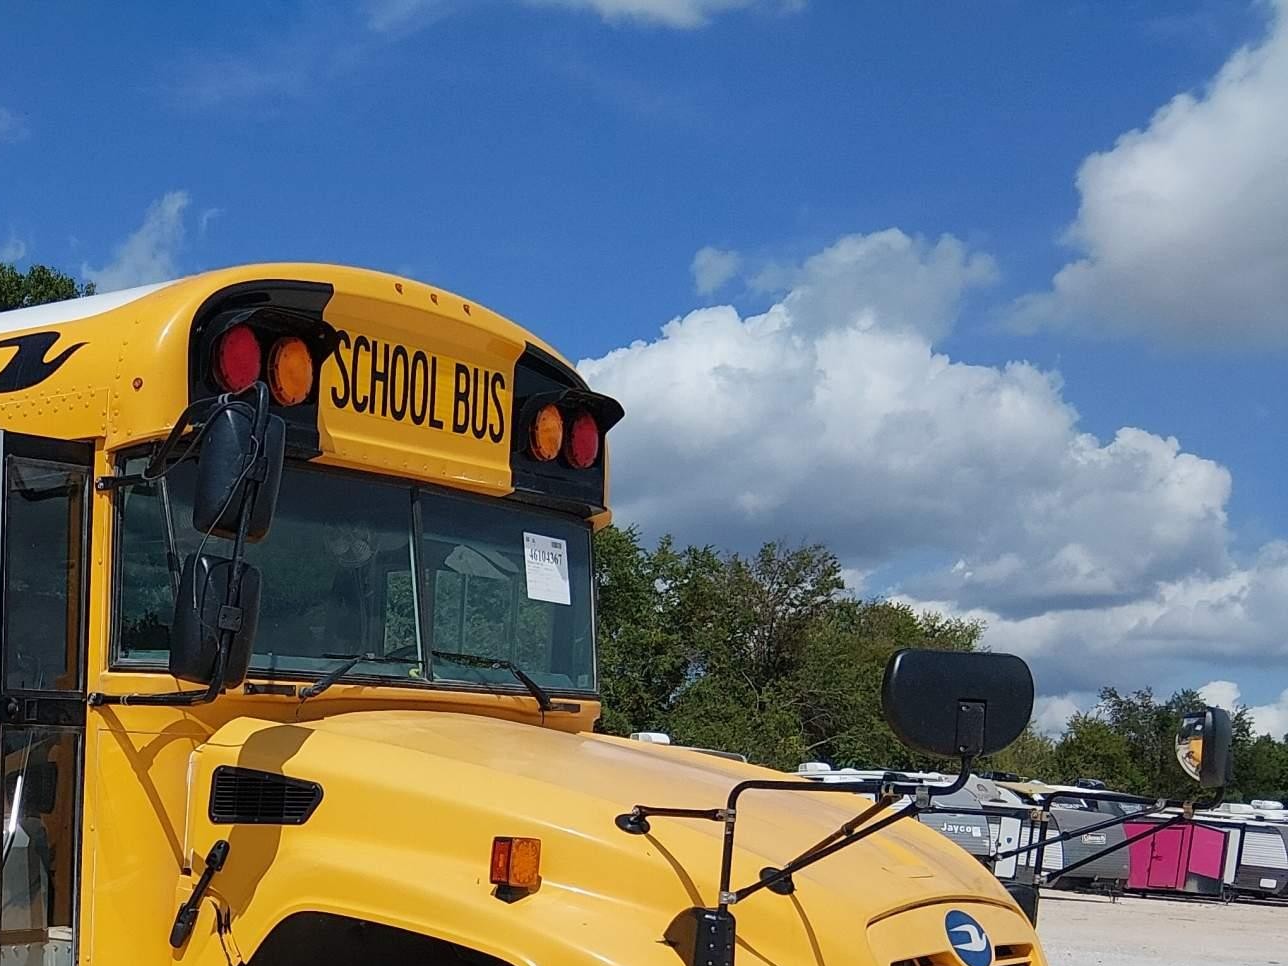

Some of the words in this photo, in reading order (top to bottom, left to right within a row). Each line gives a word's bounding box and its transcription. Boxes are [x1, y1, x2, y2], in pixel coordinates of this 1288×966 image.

[330, 329, 444, 431] SCHOOL
[452, 362, 506, 444] BUS
[940, 822, 972, 834] Jayco
